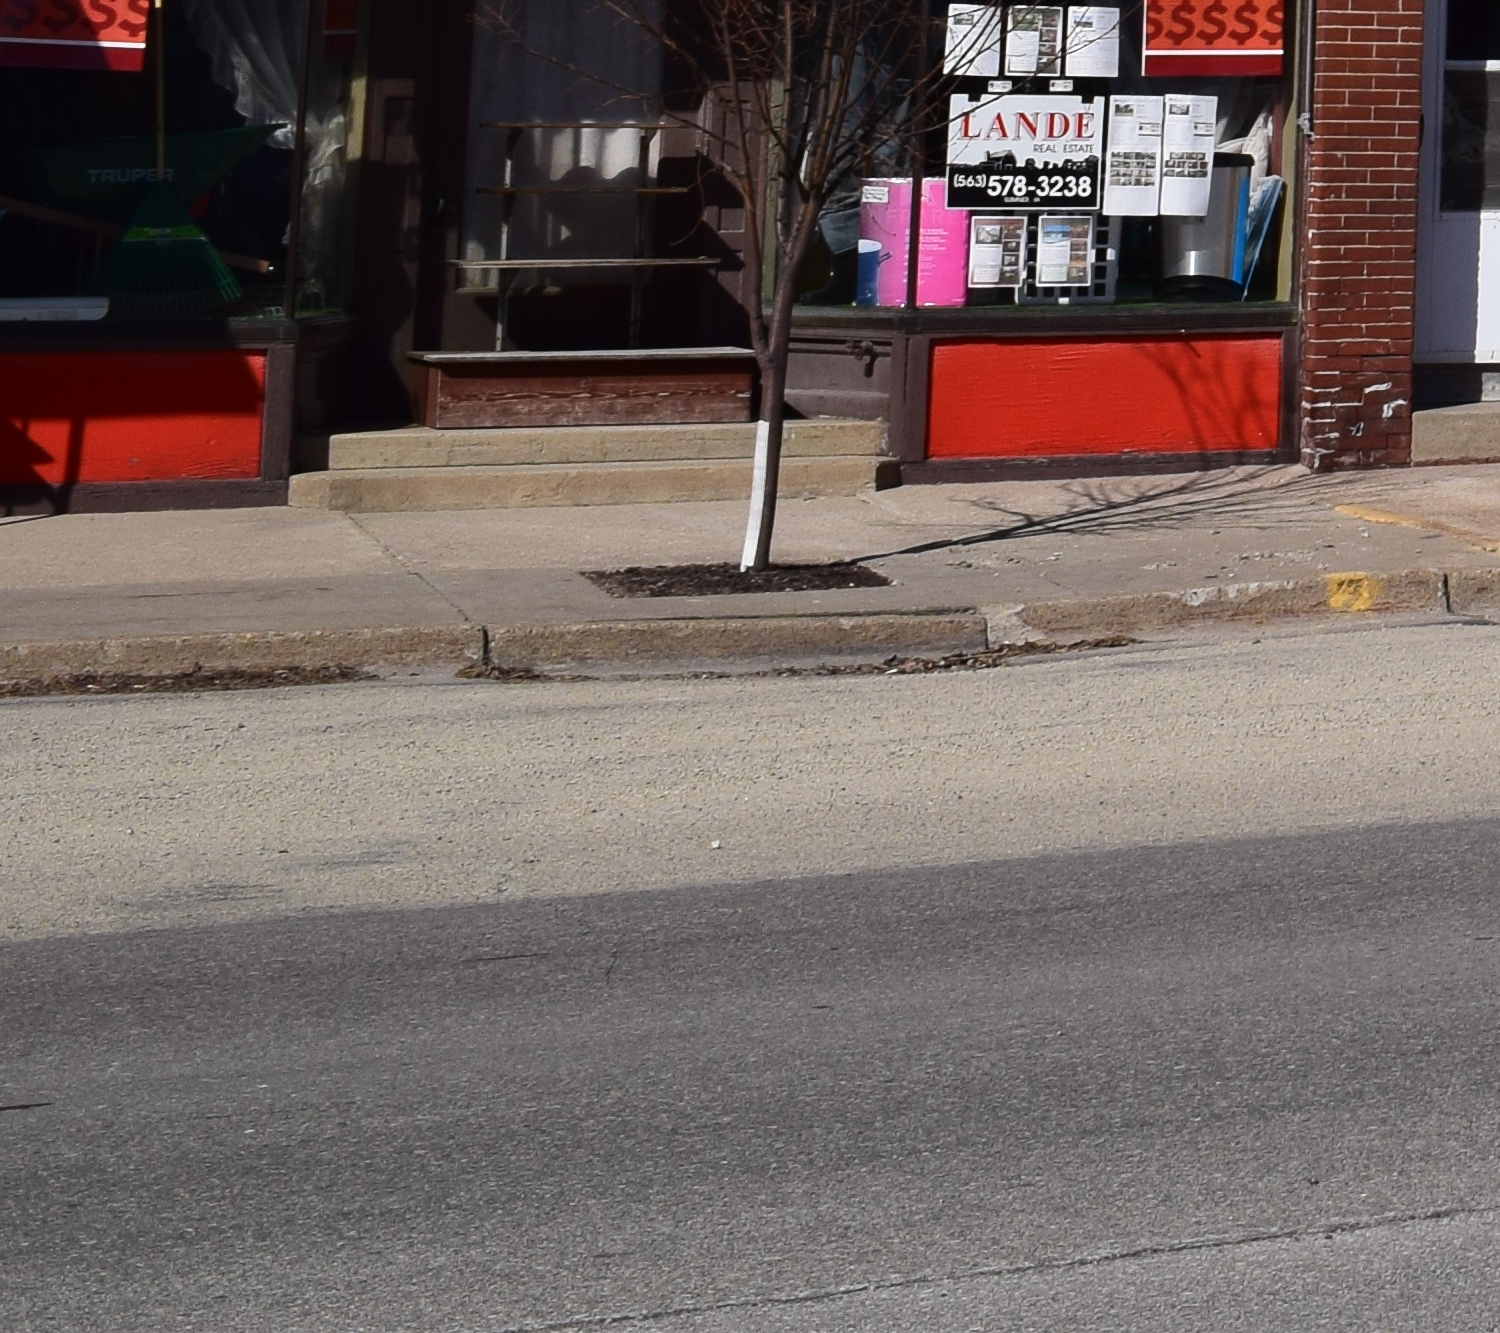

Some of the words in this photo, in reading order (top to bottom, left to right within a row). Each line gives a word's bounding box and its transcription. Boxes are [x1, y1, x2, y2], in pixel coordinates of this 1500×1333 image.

[958, 111, 1095, 142] LANDE
[1033, 144, 1057, 153] REAL
[1063, 144, 1095, 154] ESTATE
[953, 173, 987, 188] (563)
[986, 175, 1092, 197] 578-3238
